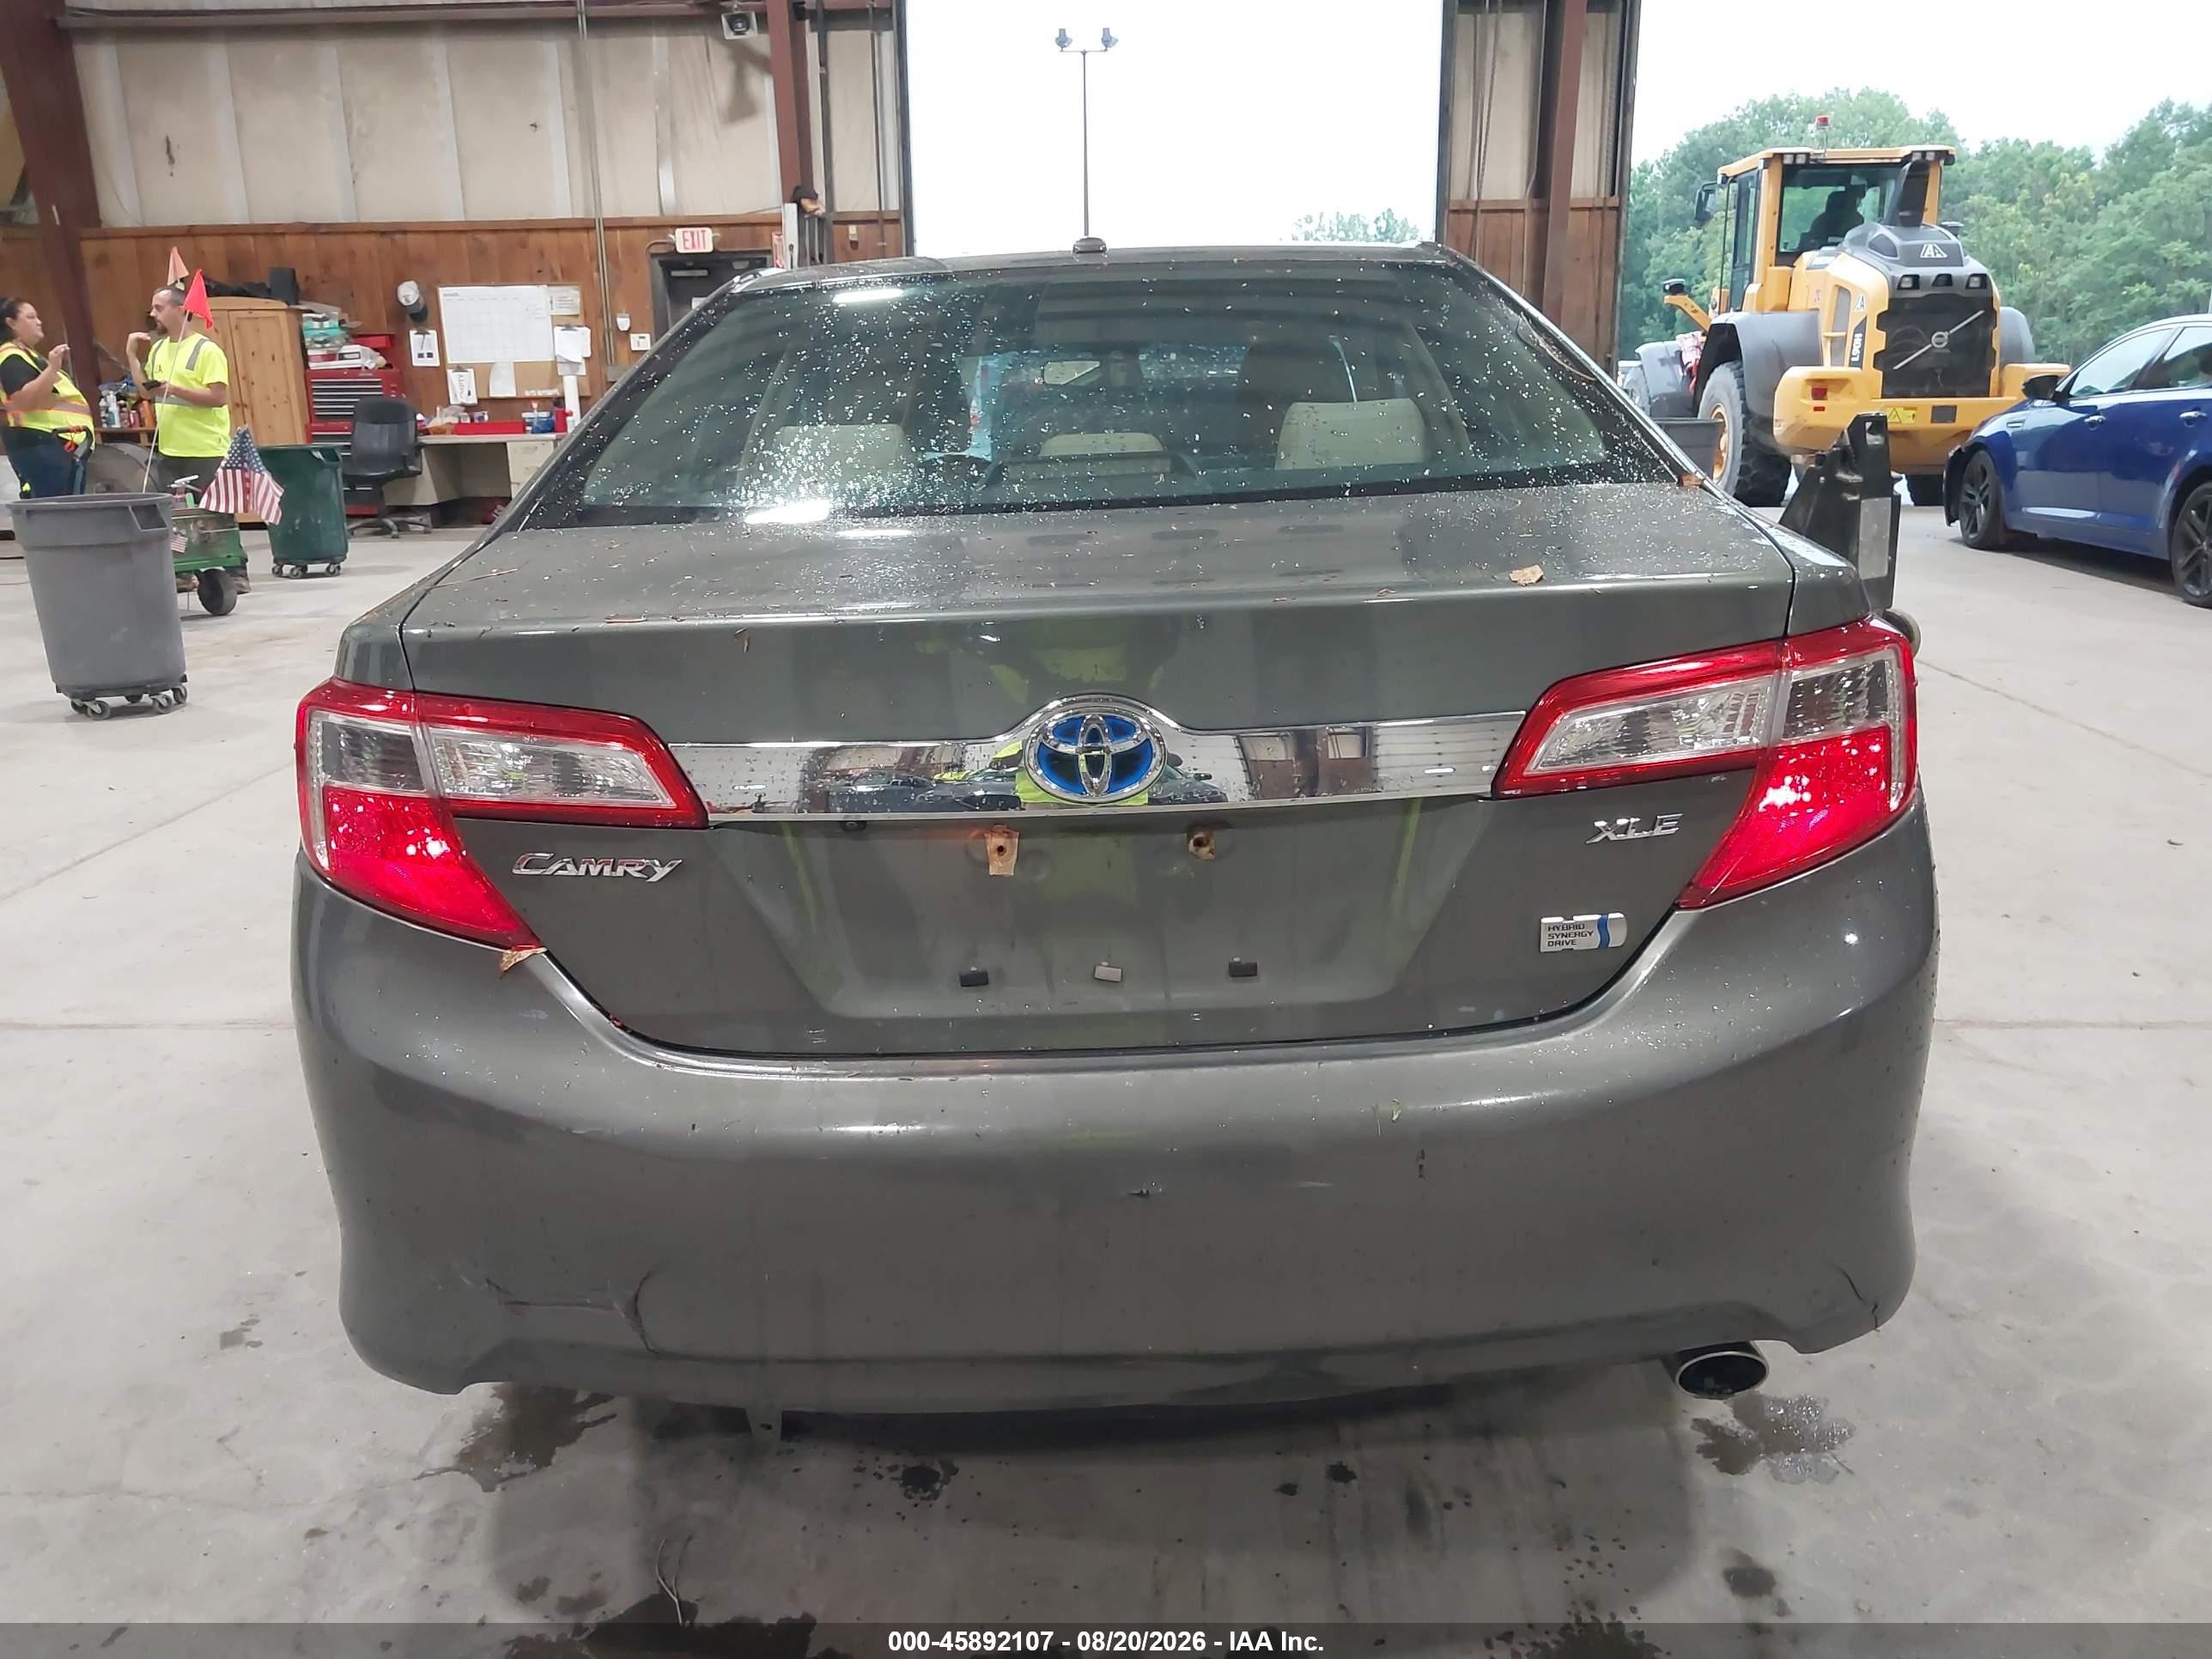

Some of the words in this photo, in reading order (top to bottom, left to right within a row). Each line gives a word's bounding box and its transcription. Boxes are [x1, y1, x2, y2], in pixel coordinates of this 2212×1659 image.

[682, 230, 706, 250] EXIT
[1585, 812, 1684, 844] XLE
[1547, 922, 1585, 932] HYBRID
[1547, 930, 1595, 940] SYNERGY
[1547, 939, 1577, 948] DRIVE
